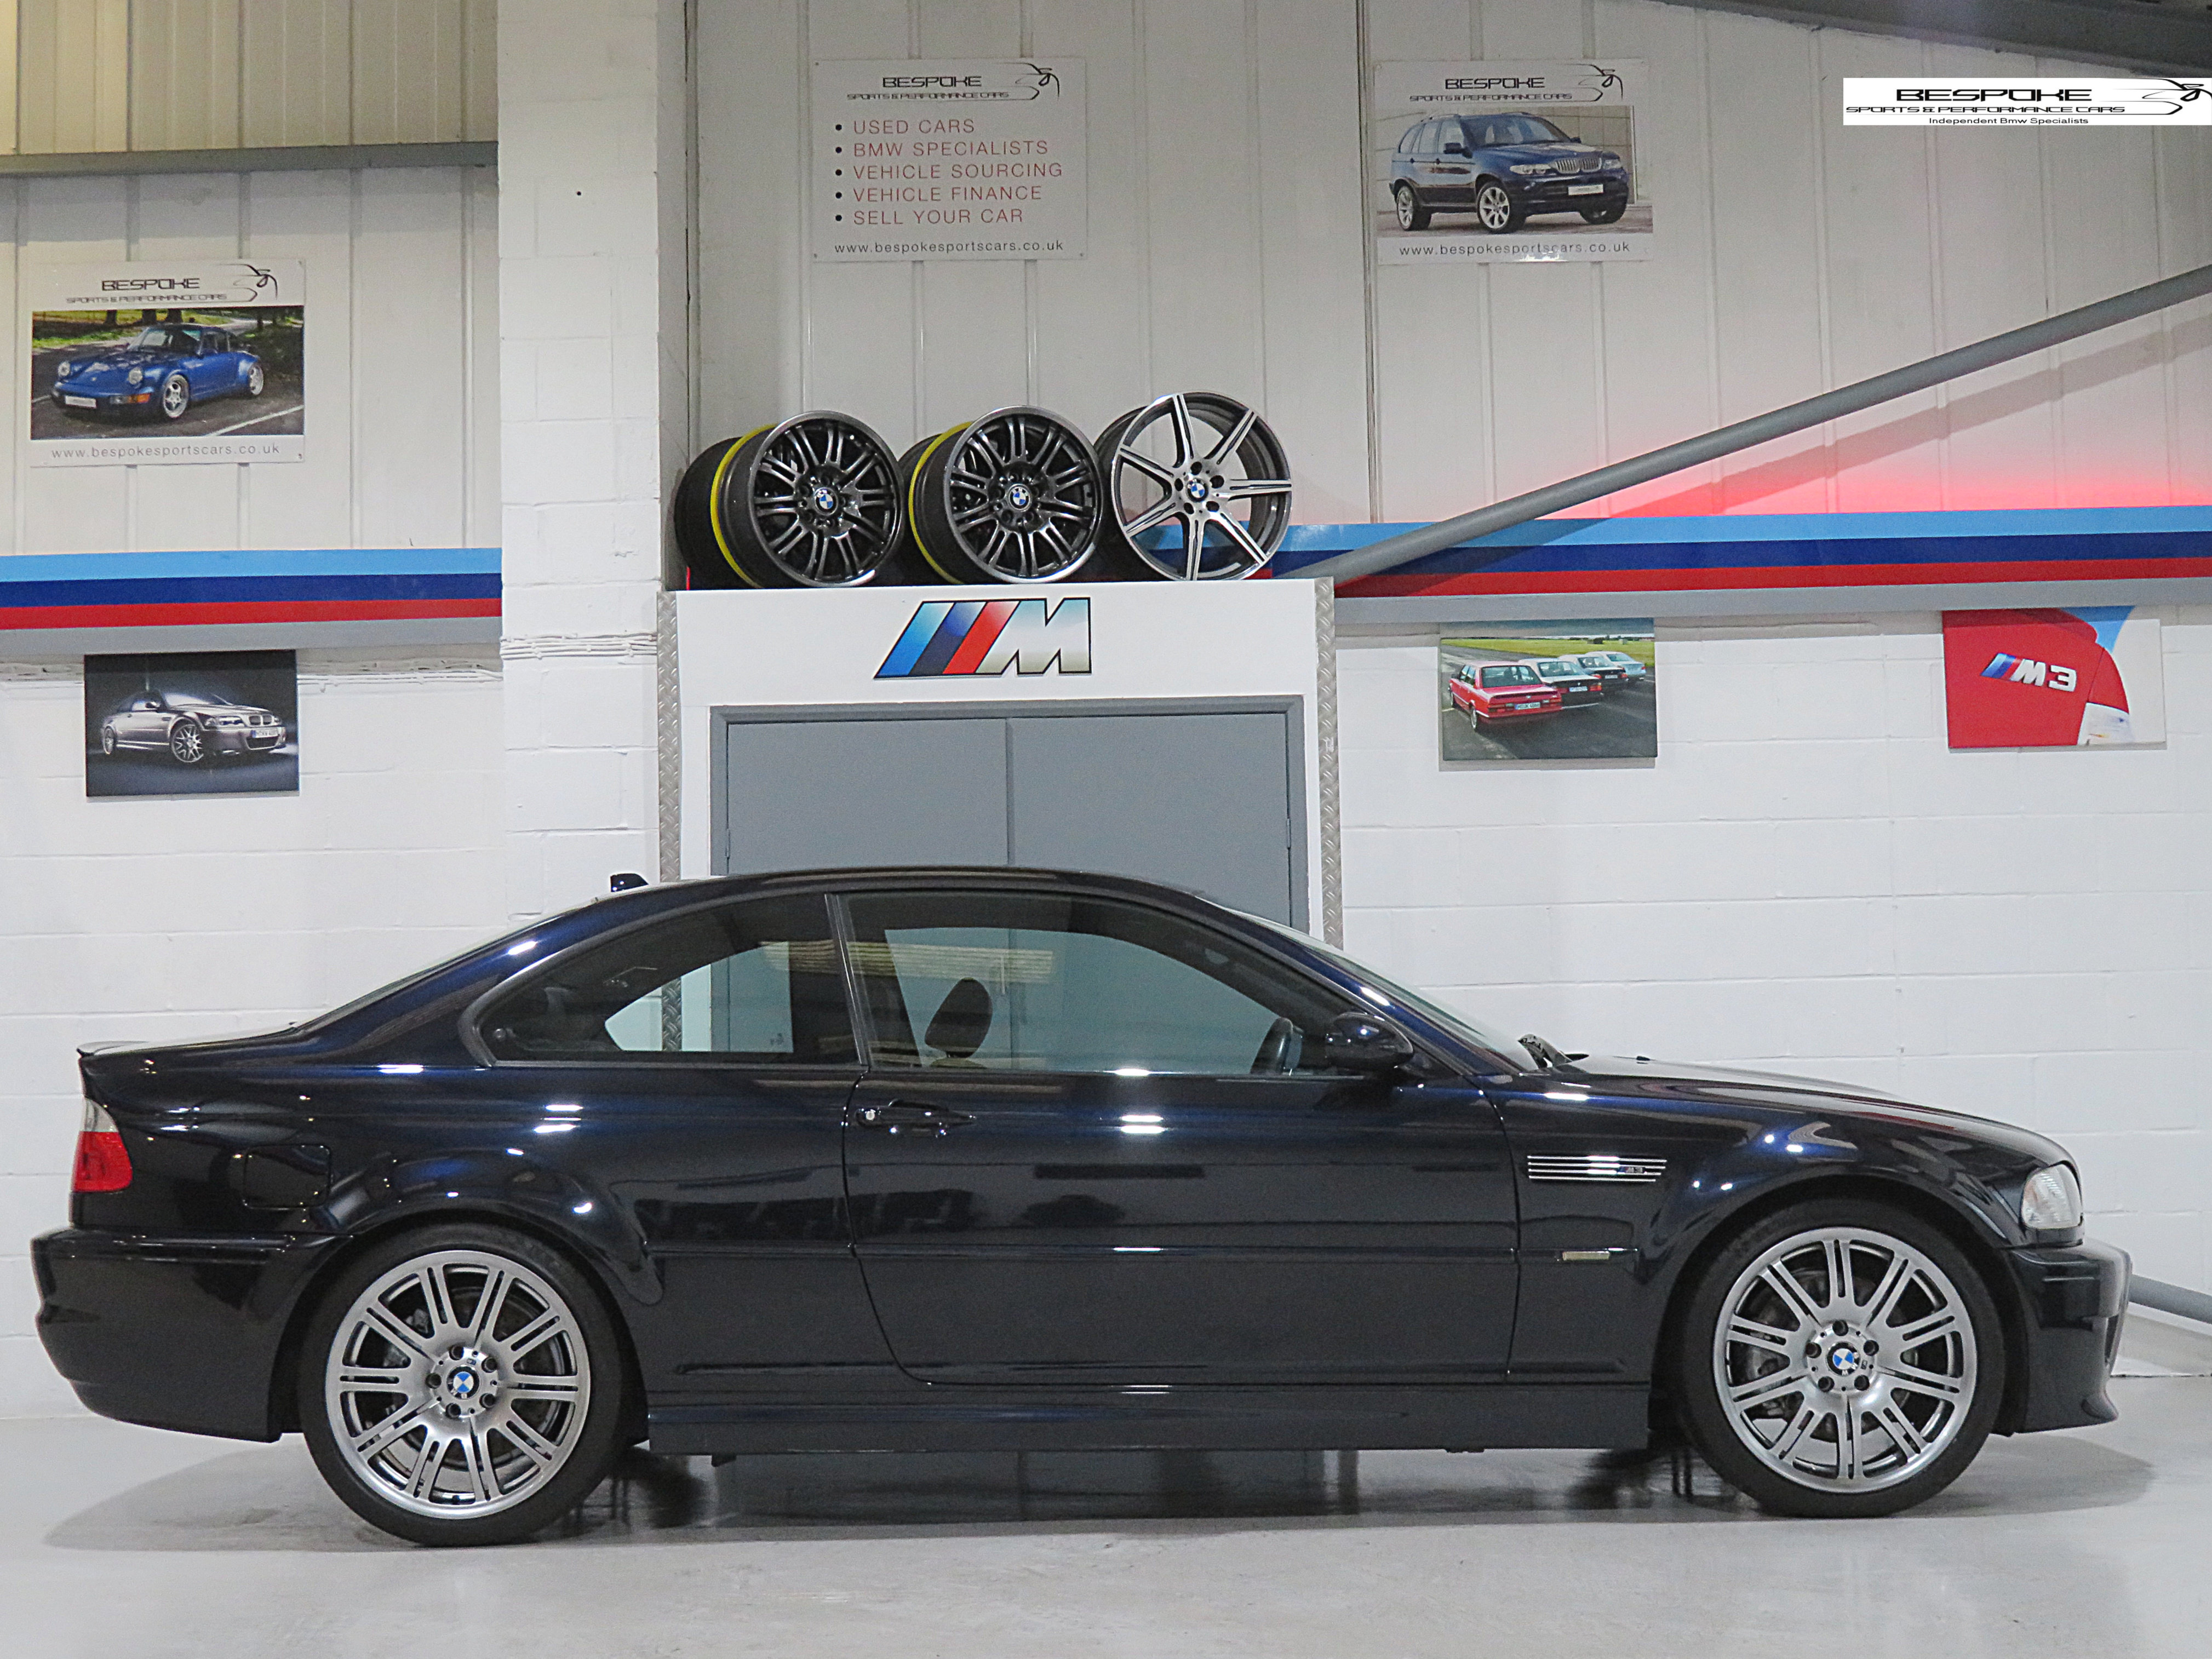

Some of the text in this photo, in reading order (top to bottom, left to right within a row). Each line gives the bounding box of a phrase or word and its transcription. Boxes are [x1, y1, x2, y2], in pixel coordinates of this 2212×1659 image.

[882, 76, 982, 88] BESPOKE
[1445, 77, 1545, 89] BESPOKE
[853, 118, 975, 135] USED CARS
[853, 140, 1048, 157] BMW SPECIALISTS
[853, 163, 1062, 180] VEHICLE SOURCING
[853, 185, 1042, 202] VEHICLE FINANCE
[853, 208, 1023, 225] SELL YOUR CAR
[834, 240, 1063, 254] www.bespokesportscars.co.uk
[1399, 242, 1630, 257] www.bespokesportscars.co.uk
[101, 278, 200, 291] BESPOKE
[51, 443, 280, 458] www.bespokesportscars.co.uk
